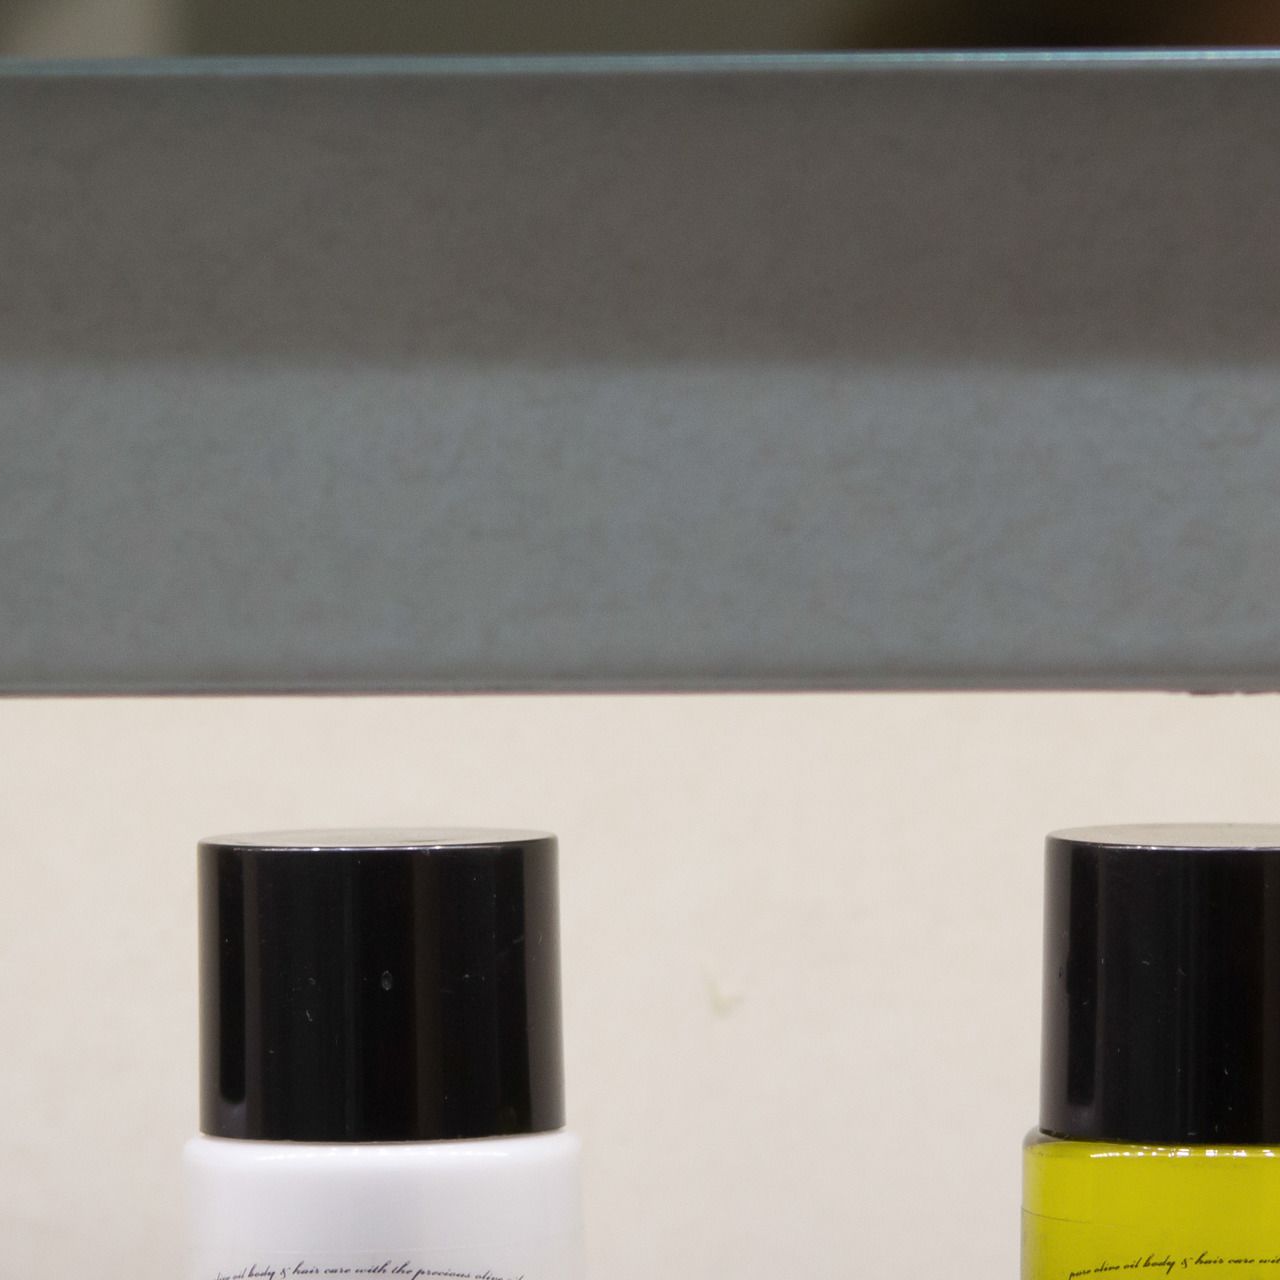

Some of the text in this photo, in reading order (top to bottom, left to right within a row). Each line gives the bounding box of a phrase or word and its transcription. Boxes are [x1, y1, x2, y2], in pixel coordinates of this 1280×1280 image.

[292, 1260, 319, 1275] hair
[323, 1267, 351, 1275] care
[354, 1259, 390, 1275] with
[391, 1260, 413, 1275] the
[1094, 1261, 1120, 1273] olive
[1123, 1257, 1142, 1269] oil
[1143, 1253, 1175, 1275] body
[1194, 1250, 1224, 1265] hair
[1228, 1257, 1255, 1265] care
